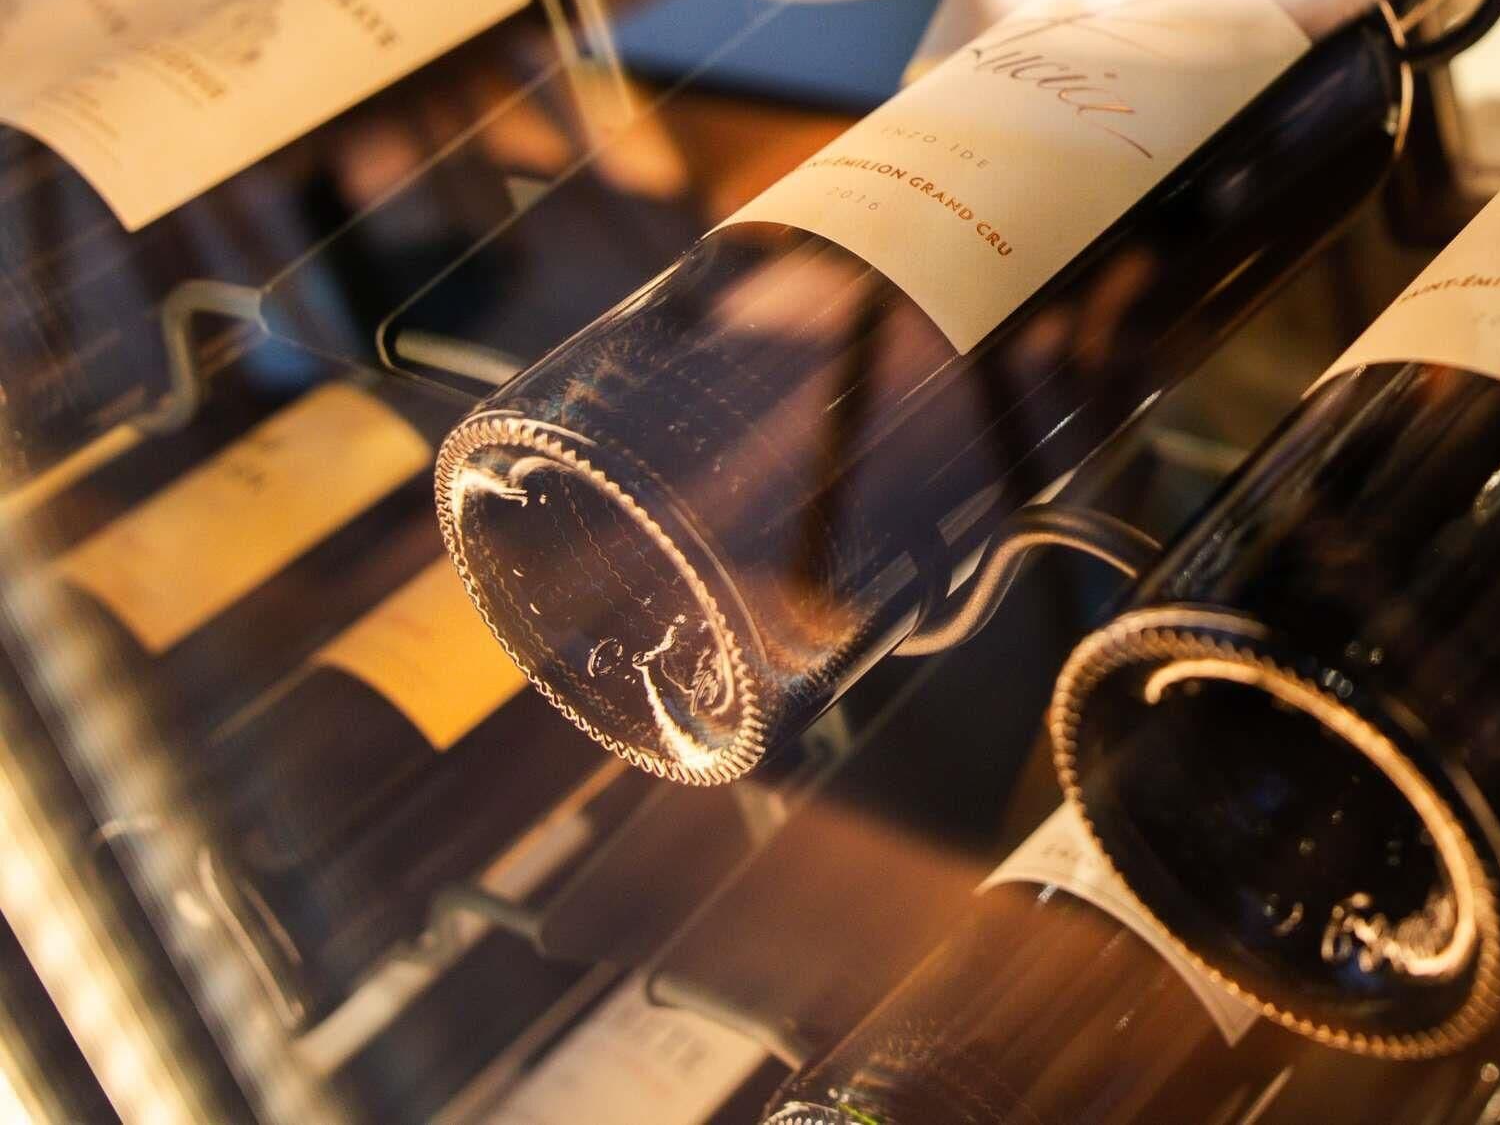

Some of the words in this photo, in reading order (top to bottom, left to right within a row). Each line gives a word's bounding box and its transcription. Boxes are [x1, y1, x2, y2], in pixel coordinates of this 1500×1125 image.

[950, 142, 991, 169] IDE
[909, 176, 974, 221] GRAND
[976, 221, 1012, 257] CRU
